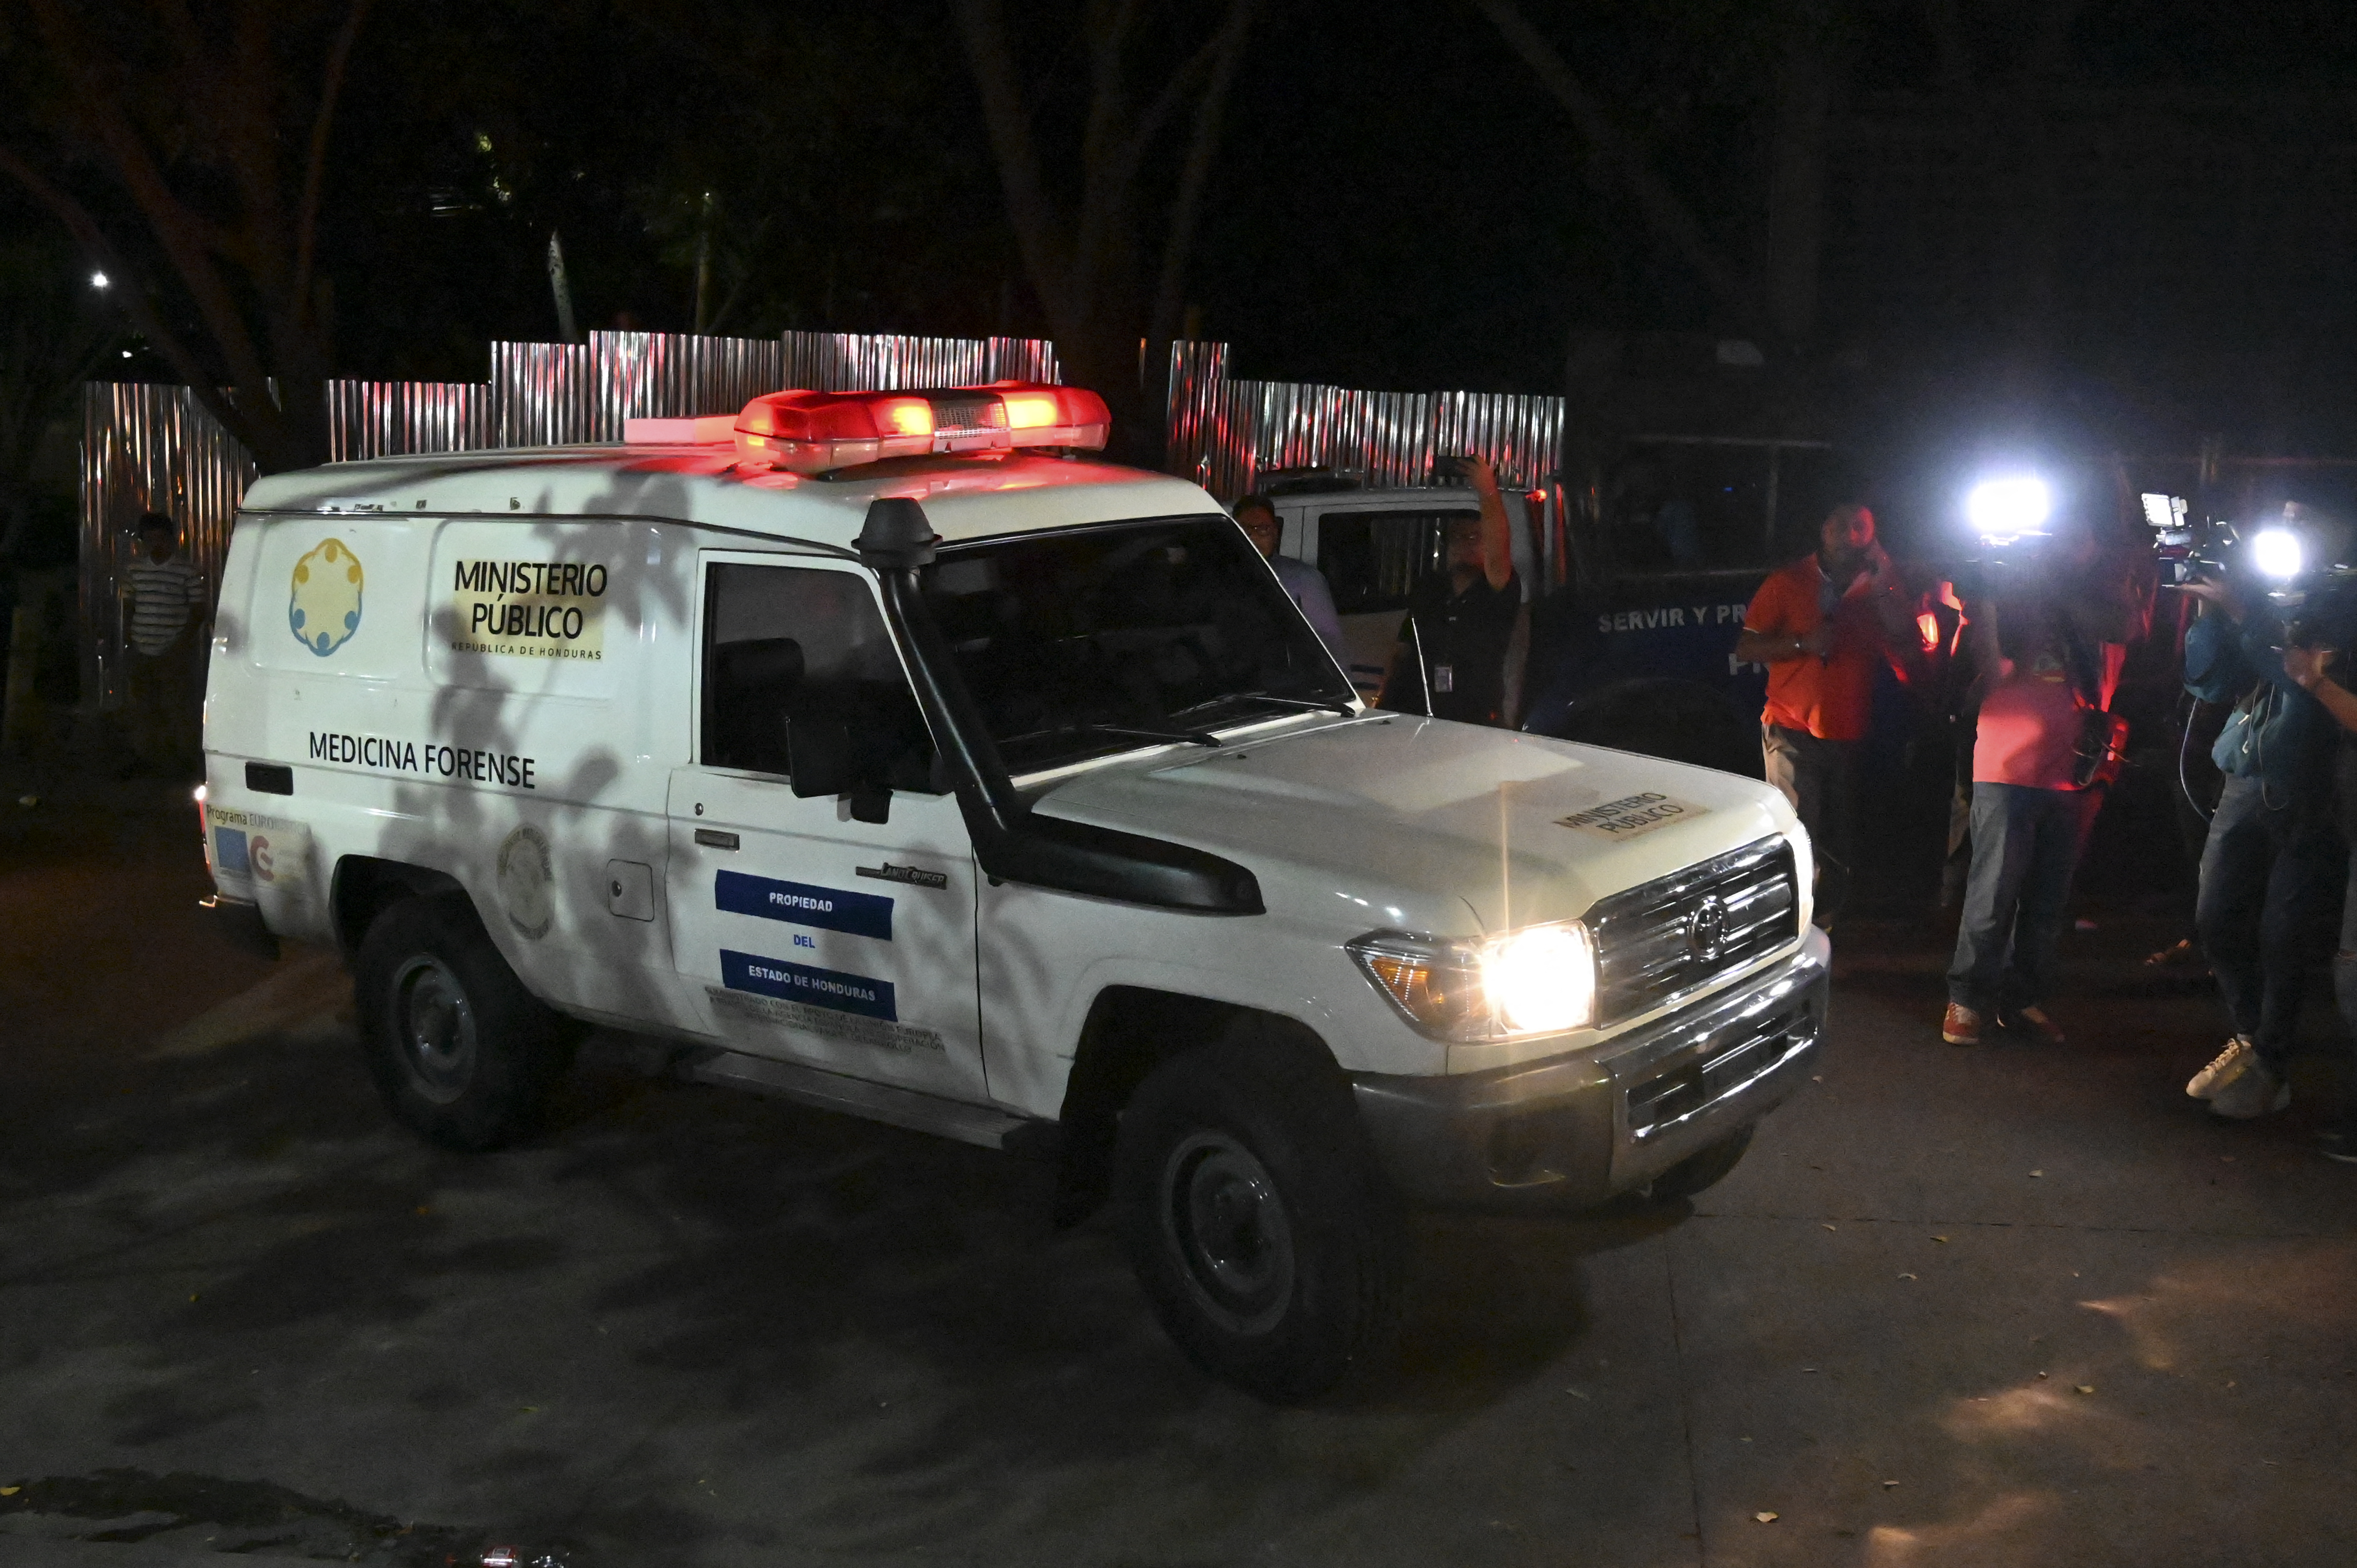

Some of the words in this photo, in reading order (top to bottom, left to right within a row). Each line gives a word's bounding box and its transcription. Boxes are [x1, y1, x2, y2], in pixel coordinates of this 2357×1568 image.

[455, 560, 608, 597] MINISTERIO
[471, 593, 583, 639] PÚBLICO
[1598, 608, 1685, 633] SERVIR
[1692, 606, 1708, 625] Y
[520, 646, 534, 656] DE
[539, 647, 601, 660] HONDURAS
[309, 731, 418, 772] MEDICINA
[425, 744, 535, 790] FORENSE
[206, 804, 247, 826] Programa
[1553, 792, 1667, 829] MINISTERIO
[769, 892, 833, 913] PROPIEDAD
[793, 934, 815, 949] DEL
[748, 965, 791, 983] ESTADO
[794, 975, 809, 988] DE
[812, 978, 876, 1001] HONDURAS
